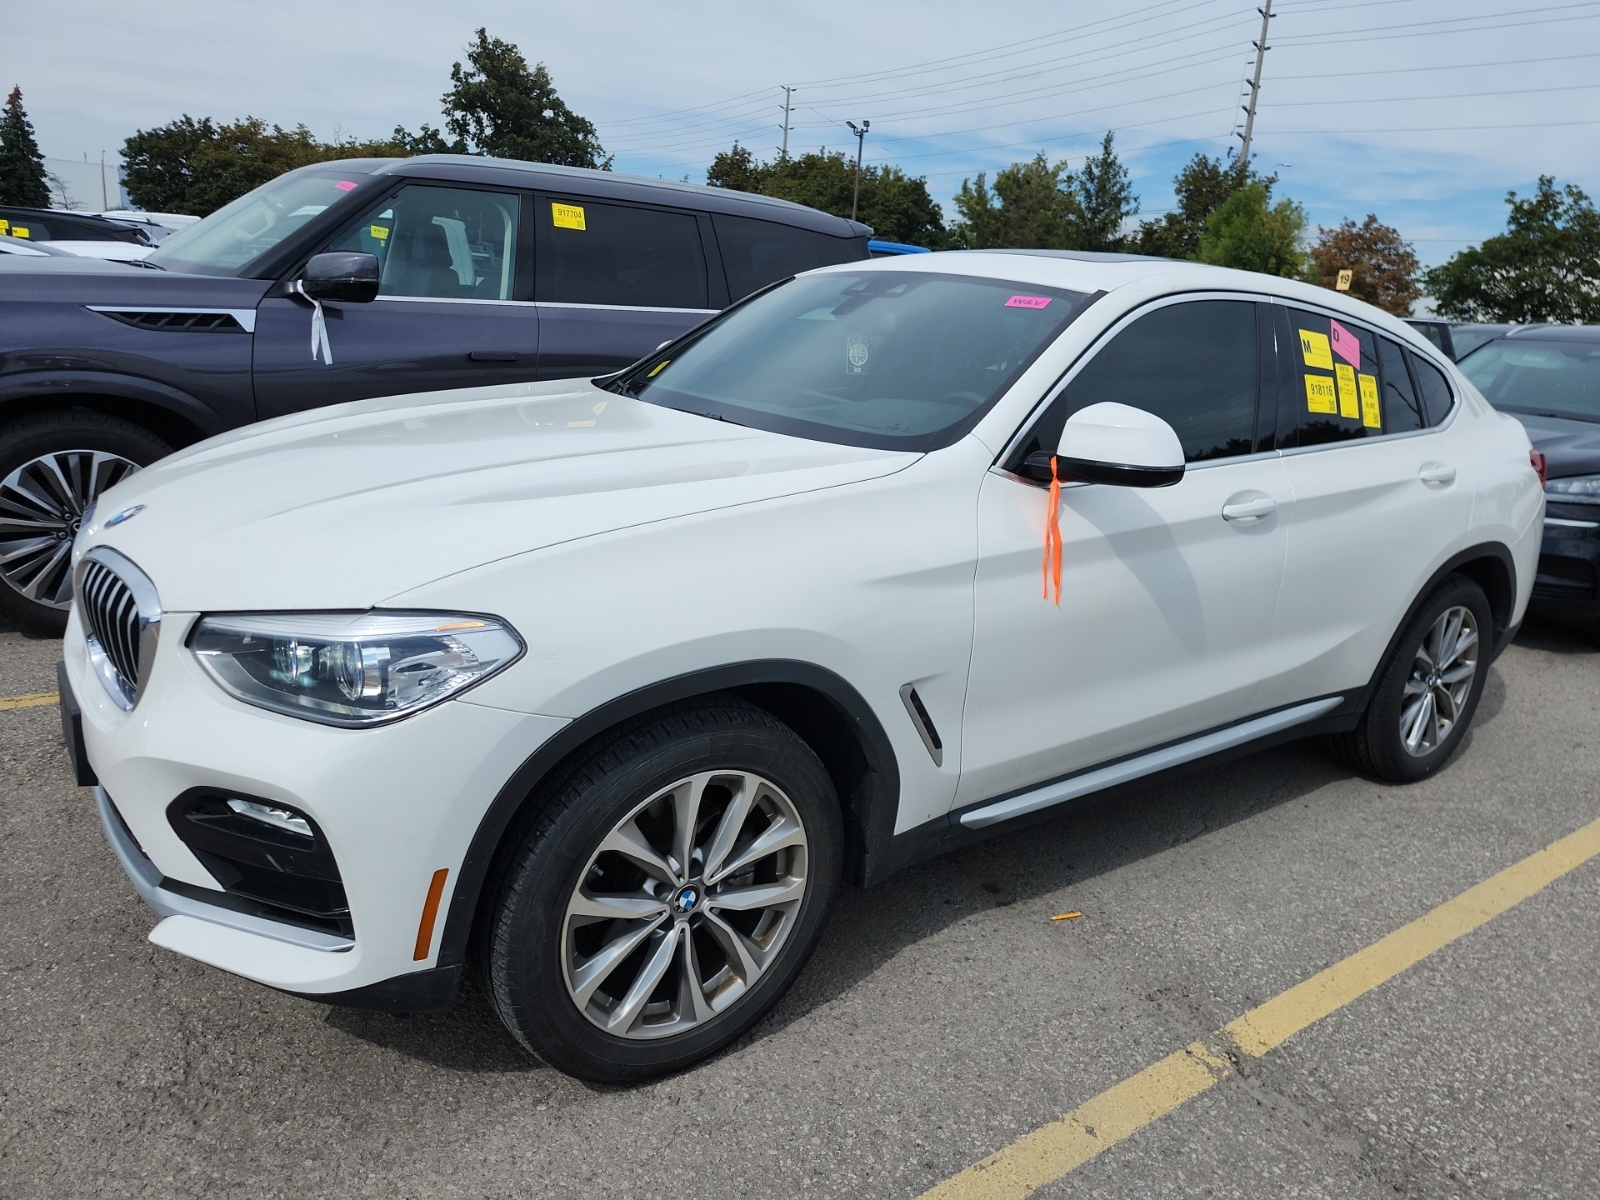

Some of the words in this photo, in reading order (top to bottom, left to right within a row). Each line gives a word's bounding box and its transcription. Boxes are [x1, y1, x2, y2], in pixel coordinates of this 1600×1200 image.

[558, 208, 582, 219] 917704
[1333, 327, 1340, 343] D
[1302, 339, 1313, 354] M
[1310, 383, 1334, 397] 918116
